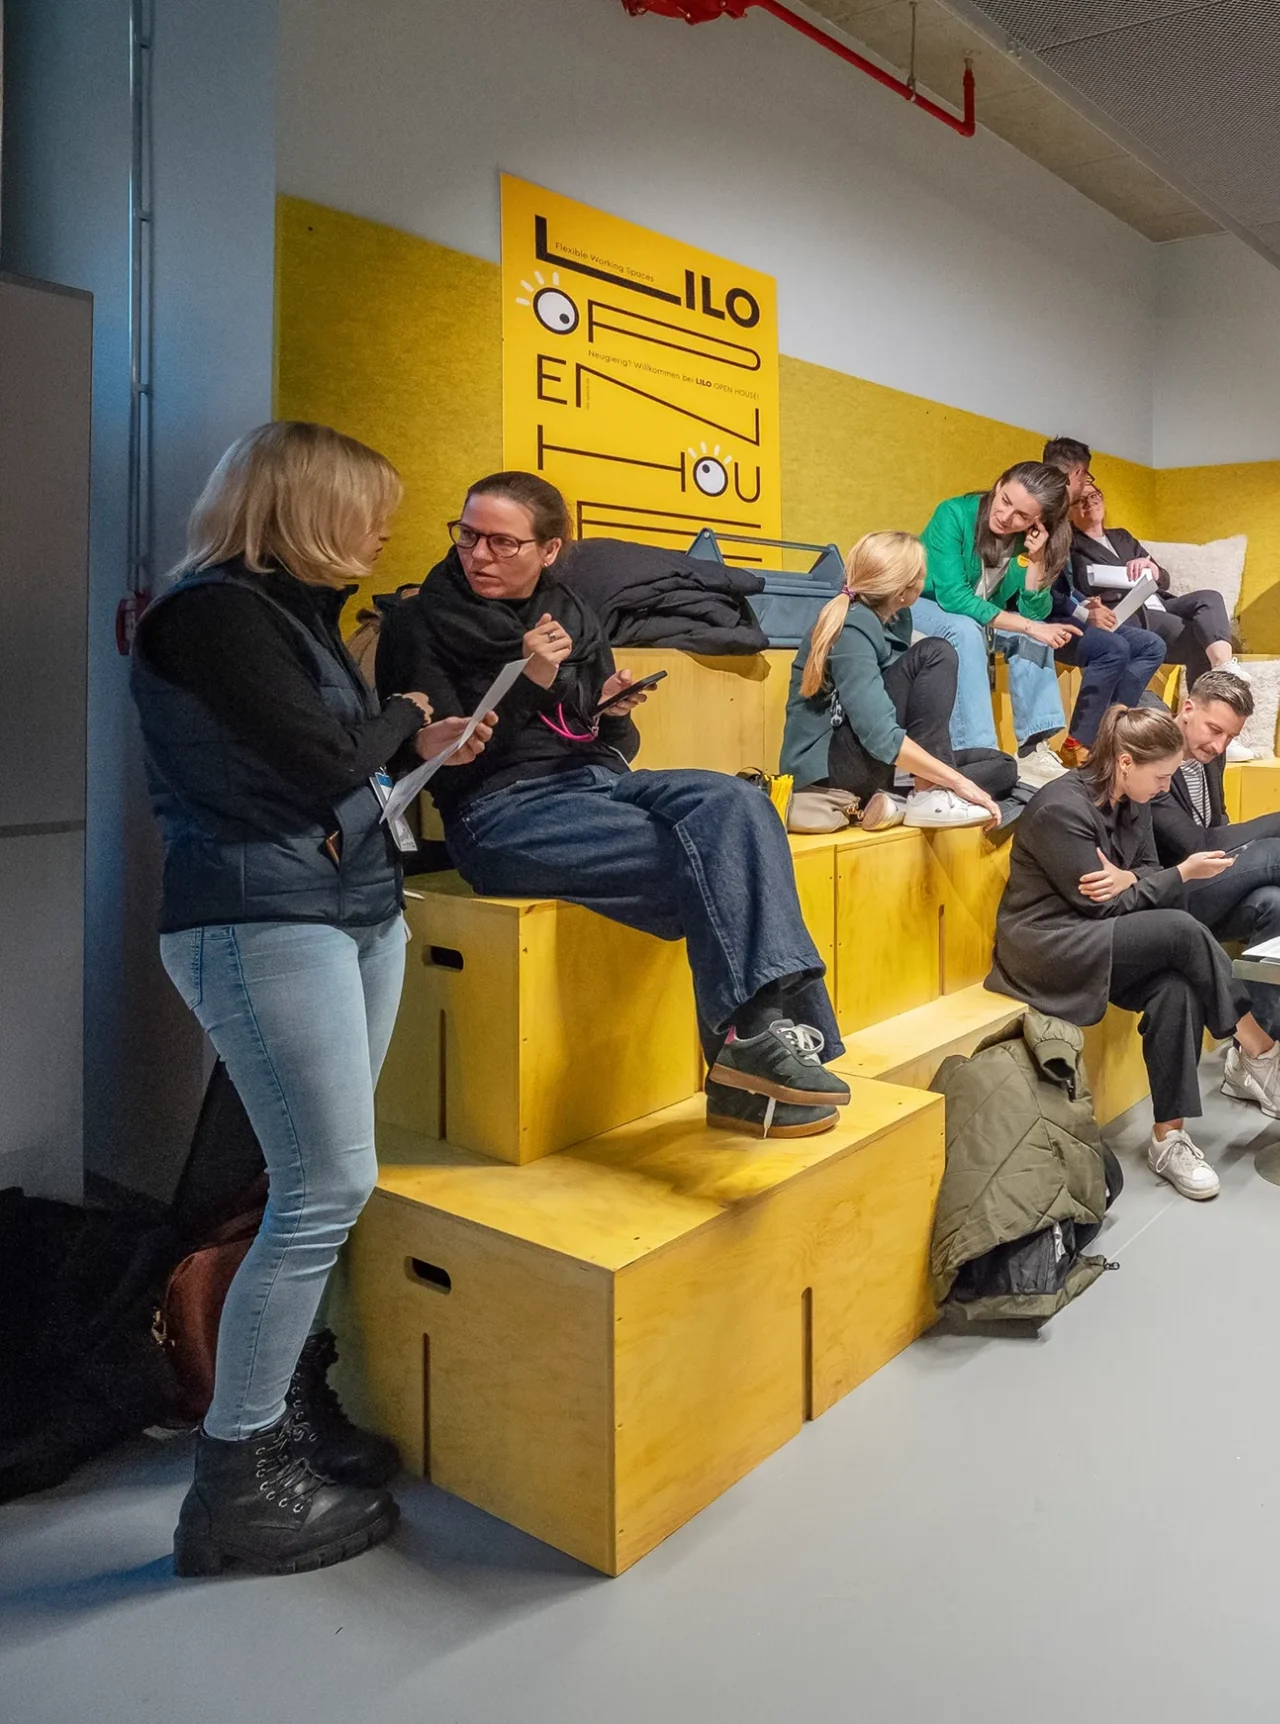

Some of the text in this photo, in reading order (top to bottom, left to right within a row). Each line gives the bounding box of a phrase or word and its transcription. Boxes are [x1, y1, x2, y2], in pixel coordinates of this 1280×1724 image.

[535, 214, 760, 328] LILO
[555, 241, 655, 283] Flexible Working Spaces
[588, 349, 632, 368] Neugierig?
[633, 361, 681, 380] Willkommen
[682, 374, 695, 384] bei
[695, 377, 712, 388] LILO
[713, 382, 733, 394] OPEN
